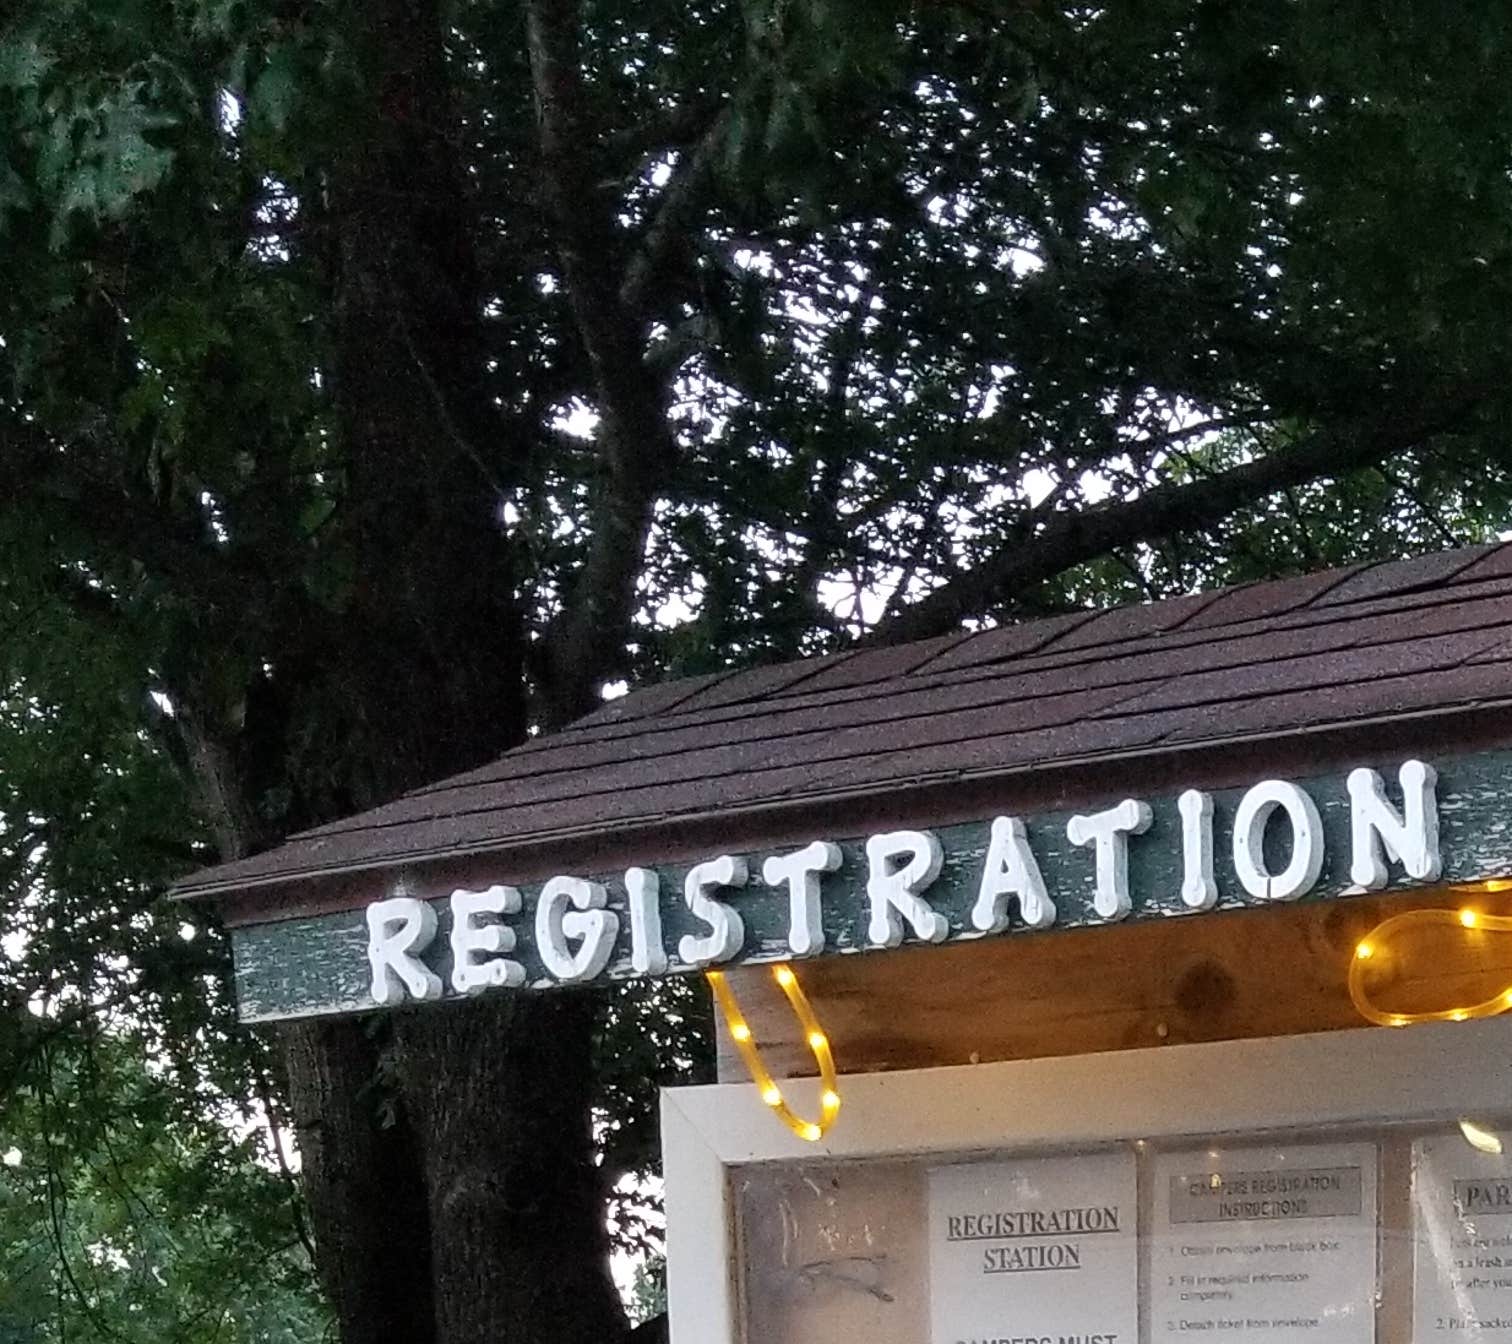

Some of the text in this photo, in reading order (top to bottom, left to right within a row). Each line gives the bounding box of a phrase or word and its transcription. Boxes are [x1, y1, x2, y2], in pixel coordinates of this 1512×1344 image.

[366, 759, 1441, 1002] REGISTRATION
[1251, 1175, 1341, 1195] REGISTRATION
[947, 1206, 1120, 1240] REGISTRATION
[983, 1244, 1081, 1272] STATION
